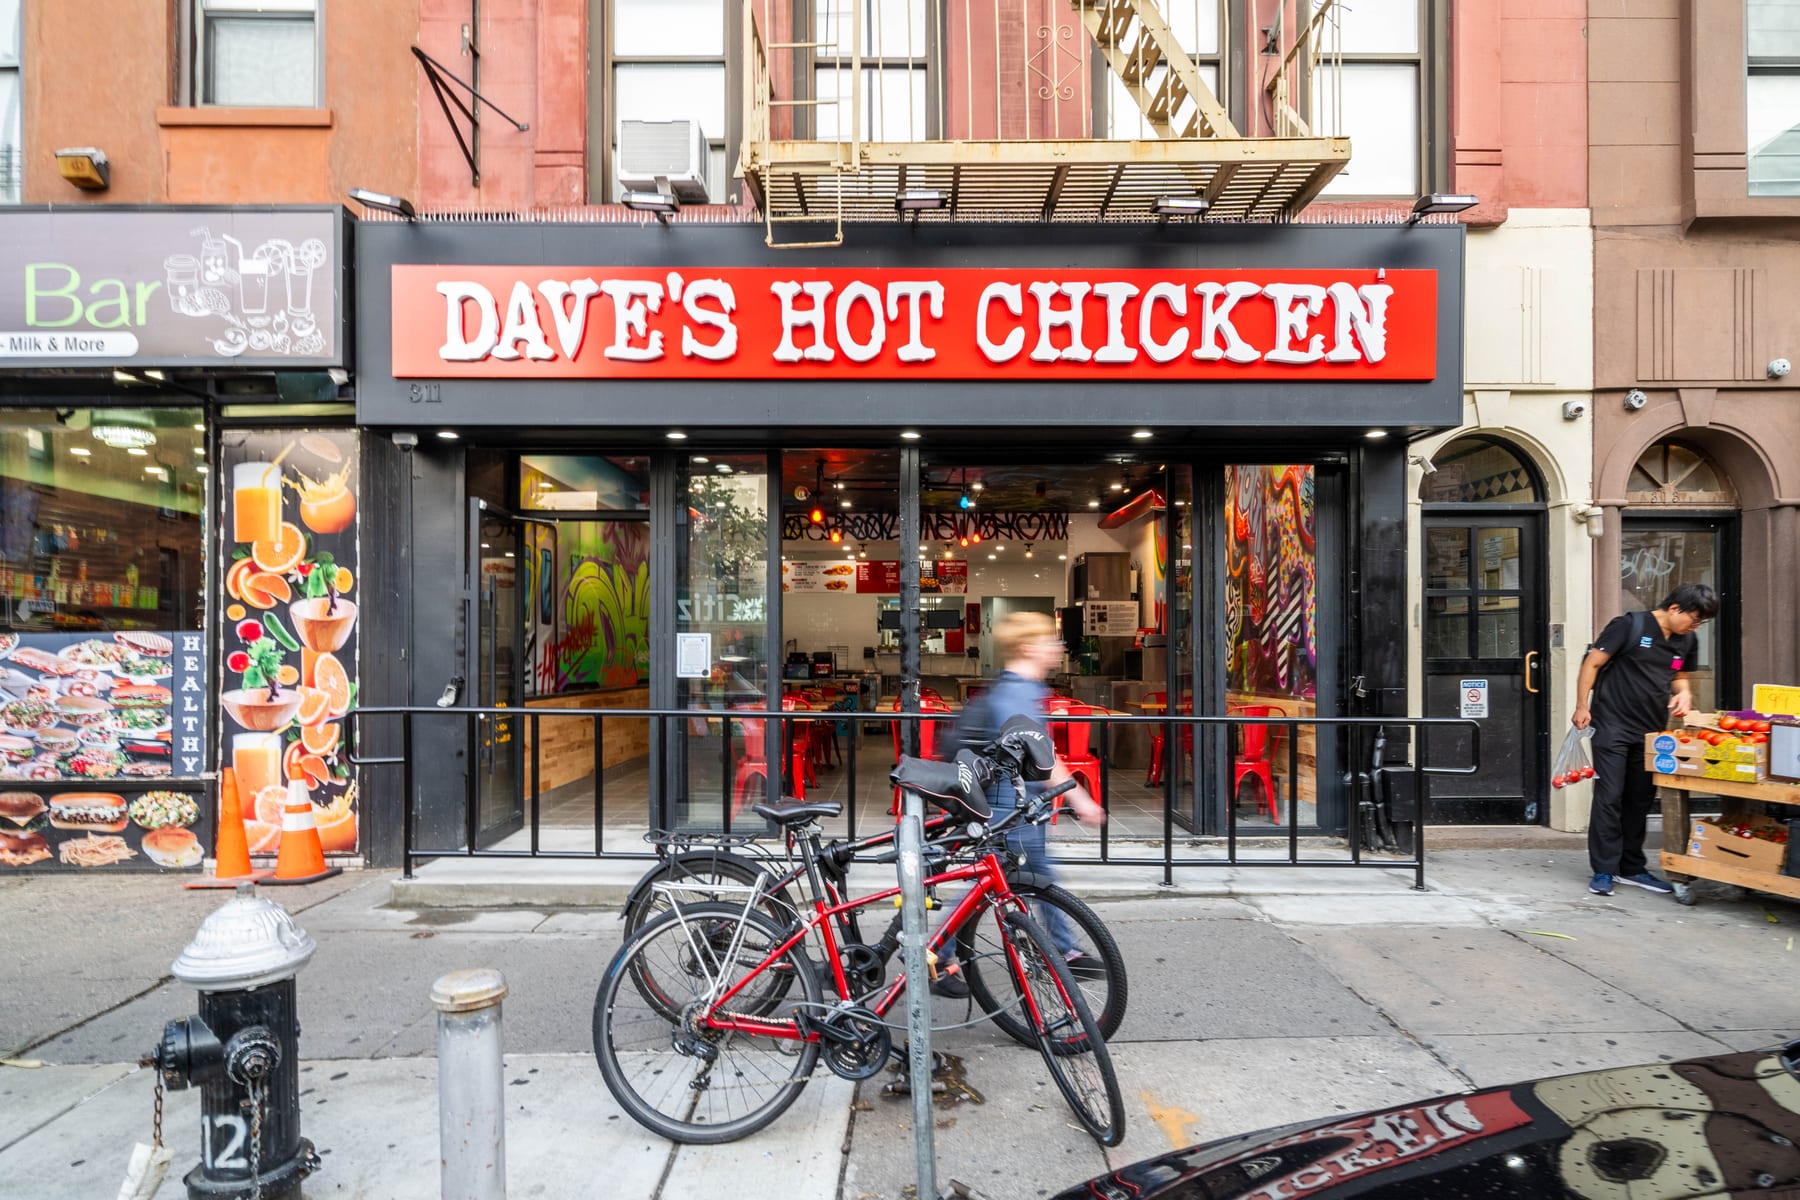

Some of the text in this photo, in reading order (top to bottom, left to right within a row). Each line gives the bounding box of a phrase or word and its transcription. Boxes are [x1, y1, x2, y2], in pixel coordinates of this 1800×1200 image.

[24, 262, 162, 328] Bar
[436, 271, 1394, 364] DAVE'S HOT CHICKEN
[9, 336, 42, 352] Milk
[47, 336, 59, 352] &
[64, 336, 105, 352] More
[408, 383, 443, 404] 311
[181, 635, 201, 773] HEALTHY
[201, 1113, 249, 1170] 12
